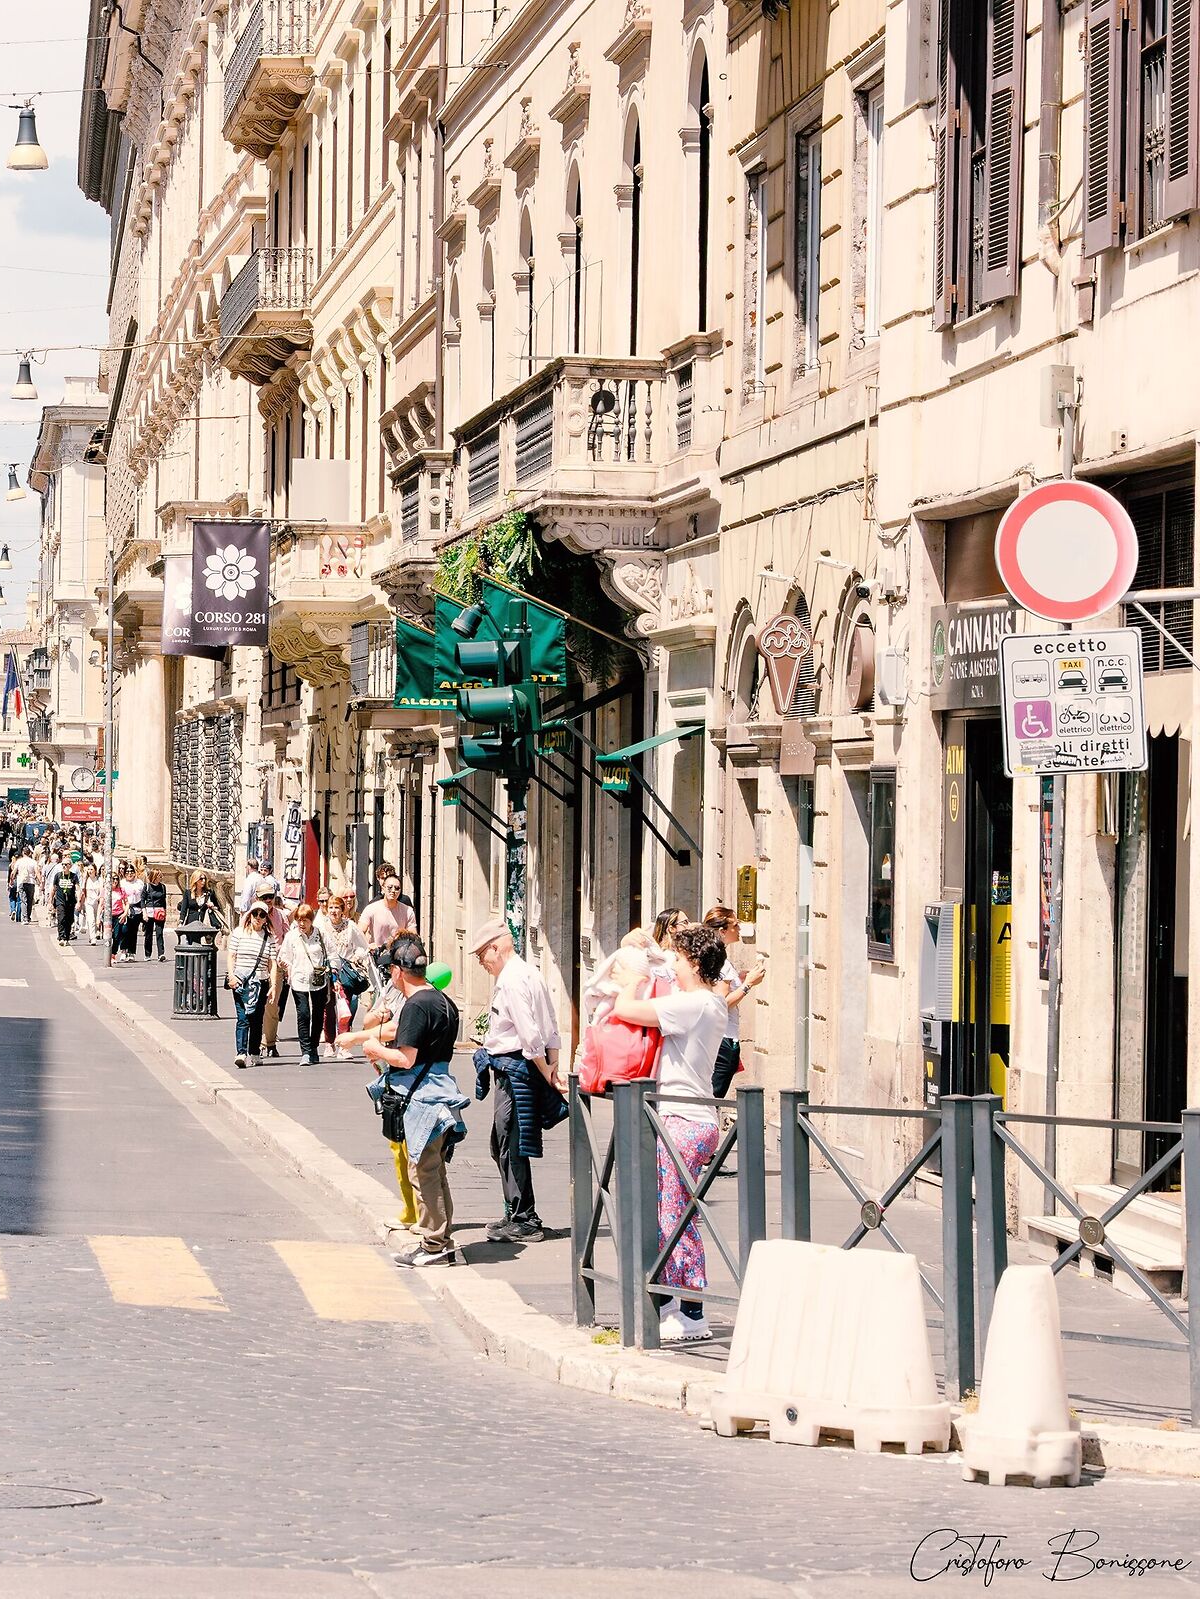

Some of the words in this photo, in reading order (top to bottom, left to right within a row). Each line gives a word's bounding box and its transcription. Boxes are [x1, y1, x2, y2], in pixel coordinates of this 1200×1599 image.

[194, 611, 242, 623] CORSO
[245, 612, 266, 625] 281
[165, 627, 191, 637] COR
[948, 610, 1012, 656] CANNABIS
[1033, 639, 1107, 654] eccetto
[1097, 657, 1127, 667] n.c.c.
[950, 661, 968, 680] STORE
[399, 697, 458, 706] ALCOTT
[1080, 739, 1129, 752] diretti
[946, 747, 964, 775] ATM
